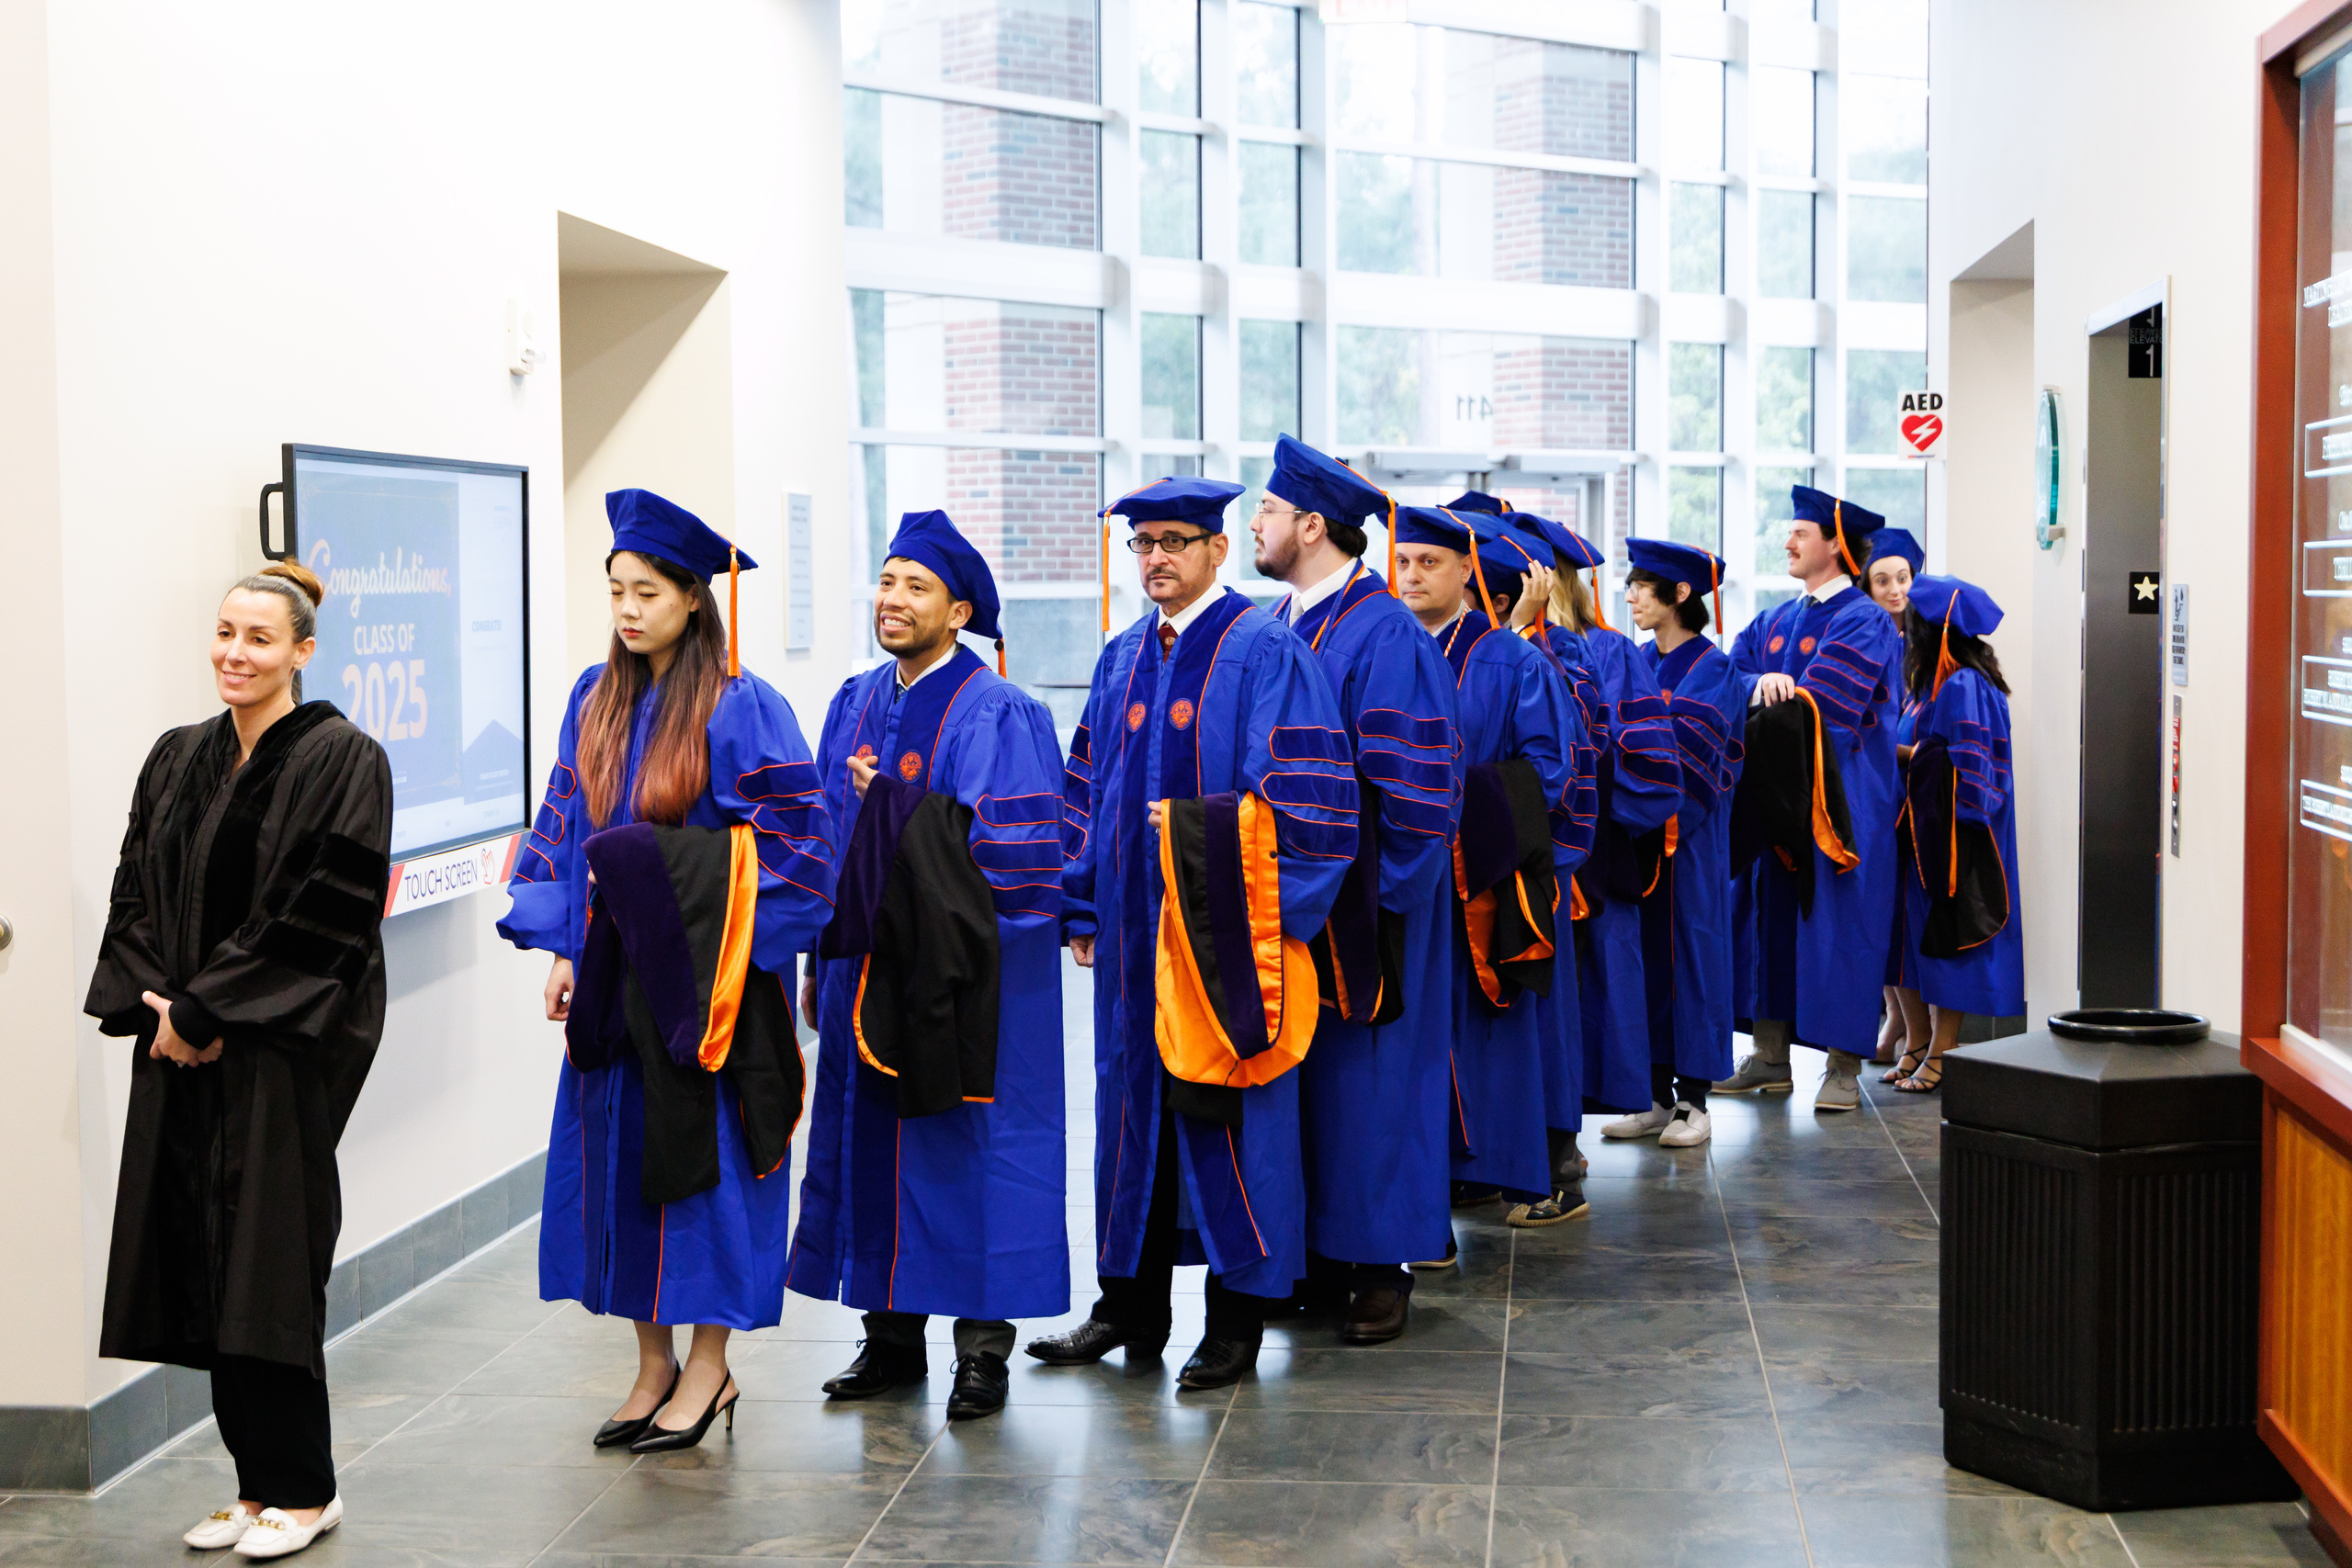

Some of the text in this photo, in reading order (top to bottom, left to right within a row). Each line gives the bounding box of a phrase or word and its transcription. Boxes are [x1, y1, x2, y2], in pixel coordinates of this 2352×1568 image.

[2145, 344, 2154, 377] 1
[1901, 393, 1943, 412] AED
[354, 624, 414, 655] CLASS OF
[342, 660, 427, 743] 2025
[404, 857, 478, 901] TOUCH SCREEN
